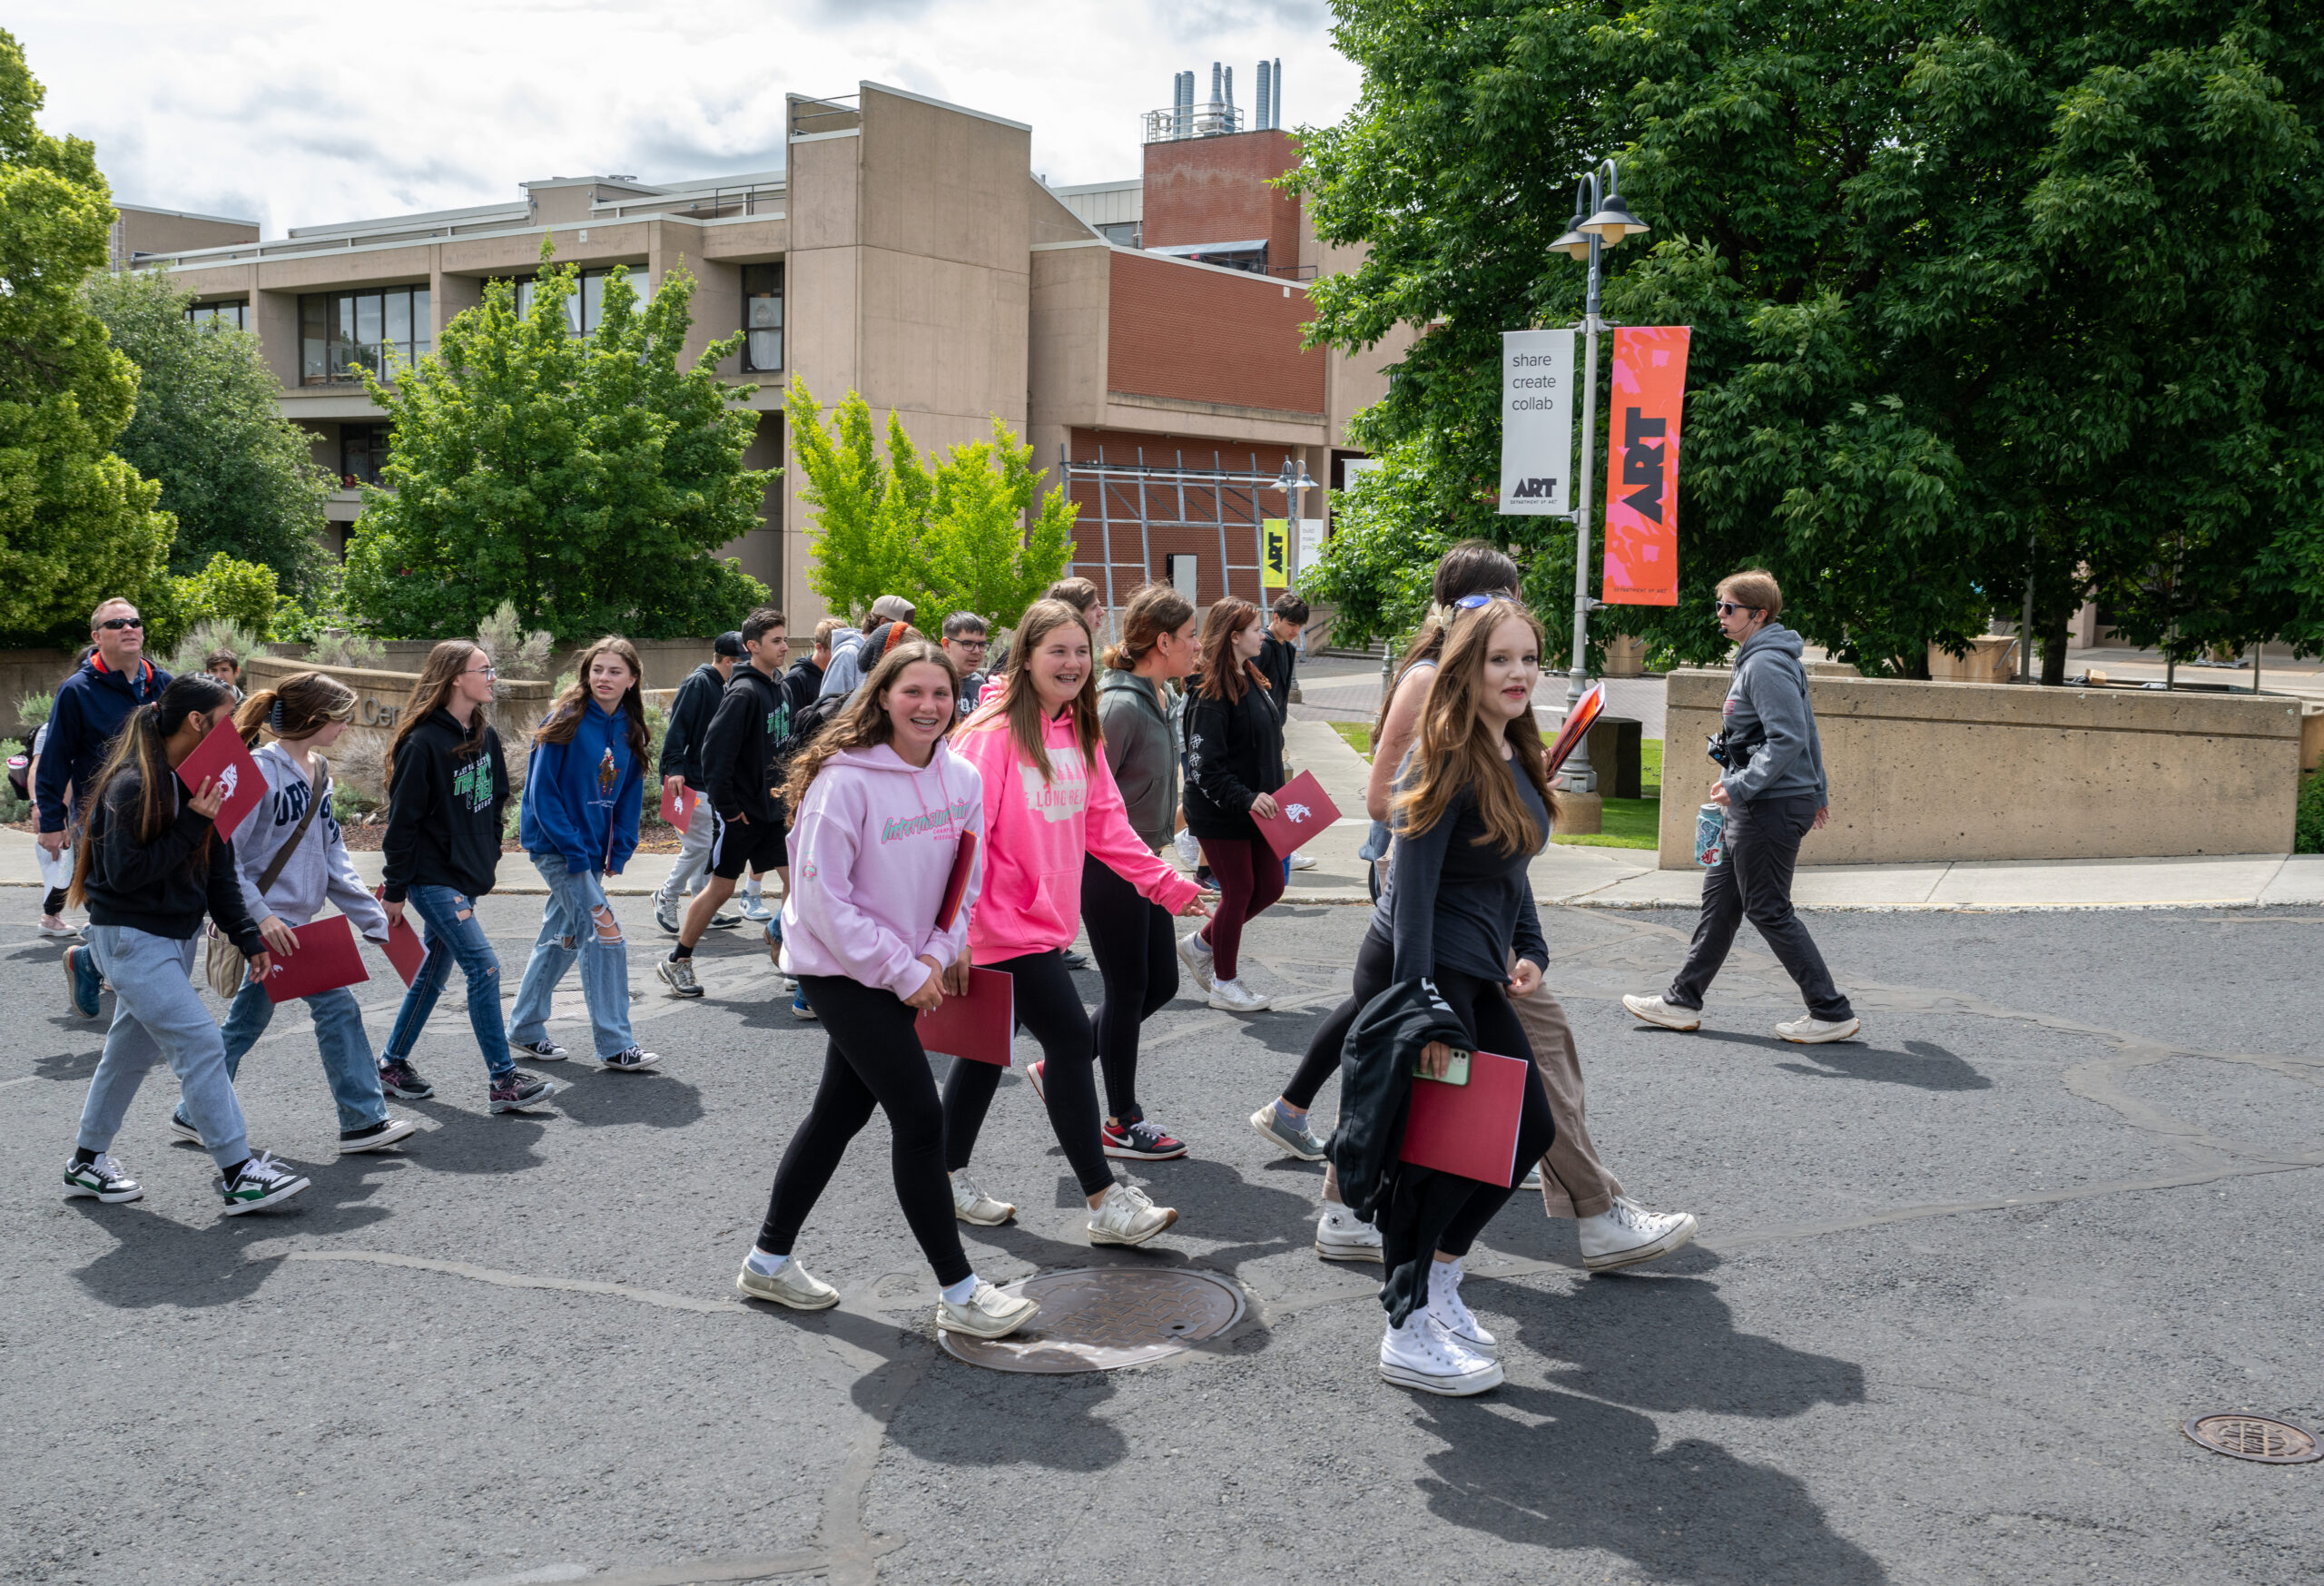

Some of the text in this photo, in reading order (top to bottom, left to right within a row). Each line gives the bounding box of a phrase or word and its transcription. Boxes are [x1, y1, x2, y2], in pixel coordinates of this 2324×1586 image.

[1512, 353, 1552, 368] share
[1512, 375, 1556, 389] create
[1512, 396, 1553, 410] collab
[1621, 407, 1667, 526] ART
[1512, 478, 1558, 498] ART
[1268, 532, 1283, 574] ART
[1037, 790, 1067, 807] LONG
